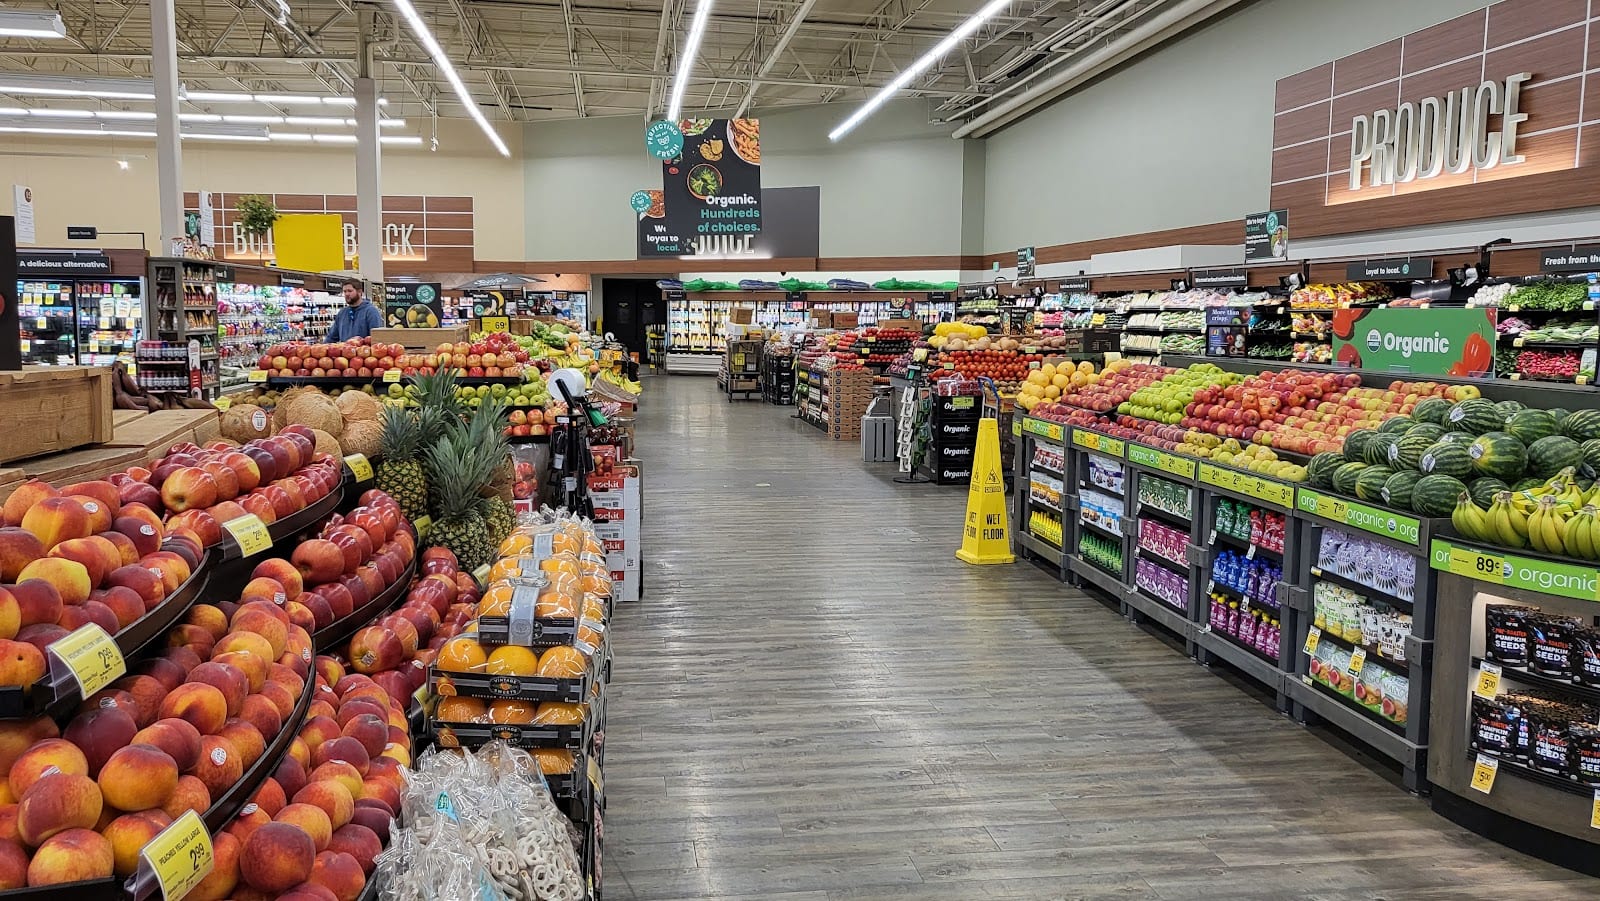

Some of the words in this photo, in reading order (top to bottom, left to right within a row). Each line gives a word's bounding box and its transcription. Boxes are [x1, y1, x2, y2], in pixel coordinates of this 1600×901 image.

[647, 123, 678, 145] PERFECTING
[1349, 72, 1532, 190] PRODUCE
[656, 143, 680, 157] FRESH
[706, 194, 757, 207] Organic.
[700, 208, 760, 218] Hundreds
[697, 222, 710, 232] of
[711, 221, 761, 232] choices.
[696, 234, 754, 254] JUICE
[27, 260, 62, 268] delicious
[63, 260, 108, 268] alternative.
[1545, 256, 1566, 265] Fresh
[1568, 255, 1587, 264] from
[1365, 267, 1379, 277] Loyal
[1384, 331, 1449, 358] Organic
[944, 425, 970, 433] Organic
[944, 447, 970, 456] Organic
[944, 470, 970, 479] Organic
[593, 480, 620, 488] rockit
[594, 512, 620, 520] rockit
[986, 514, 1000, 525] WET
[1347, 508, 1385, 529] organic
[983, 528, 1004, 540] FLOOR
[1399, 523, 1419, 542] org
[1476, 556, 1500, 573] 89¢
[1377, 569, 1393, 577] SEED
[1519, 566, 1597, 593] organic
[1495, 634, 1526, 643] PUMPKIN
[1495, 640, 1526, 650] SEEDS
[1536, 644, 1568, 654] PUMPKIN
[98, 647, 113, 669] 299
[1535, 650, 1568, 662] SEEDS
[1480, 724, 1508, 736] PUMPKIN
[1478, 731, 1506, 743] SEEDS
[1536, 741, 1567, 753] PUMPKIN
[1536, 748, 1566, 761] SEEDS
[158, 848, 177, 866] PEACHES
[189, 827, 201, 841] LARGE
[189, 843, 204, 871] 299
